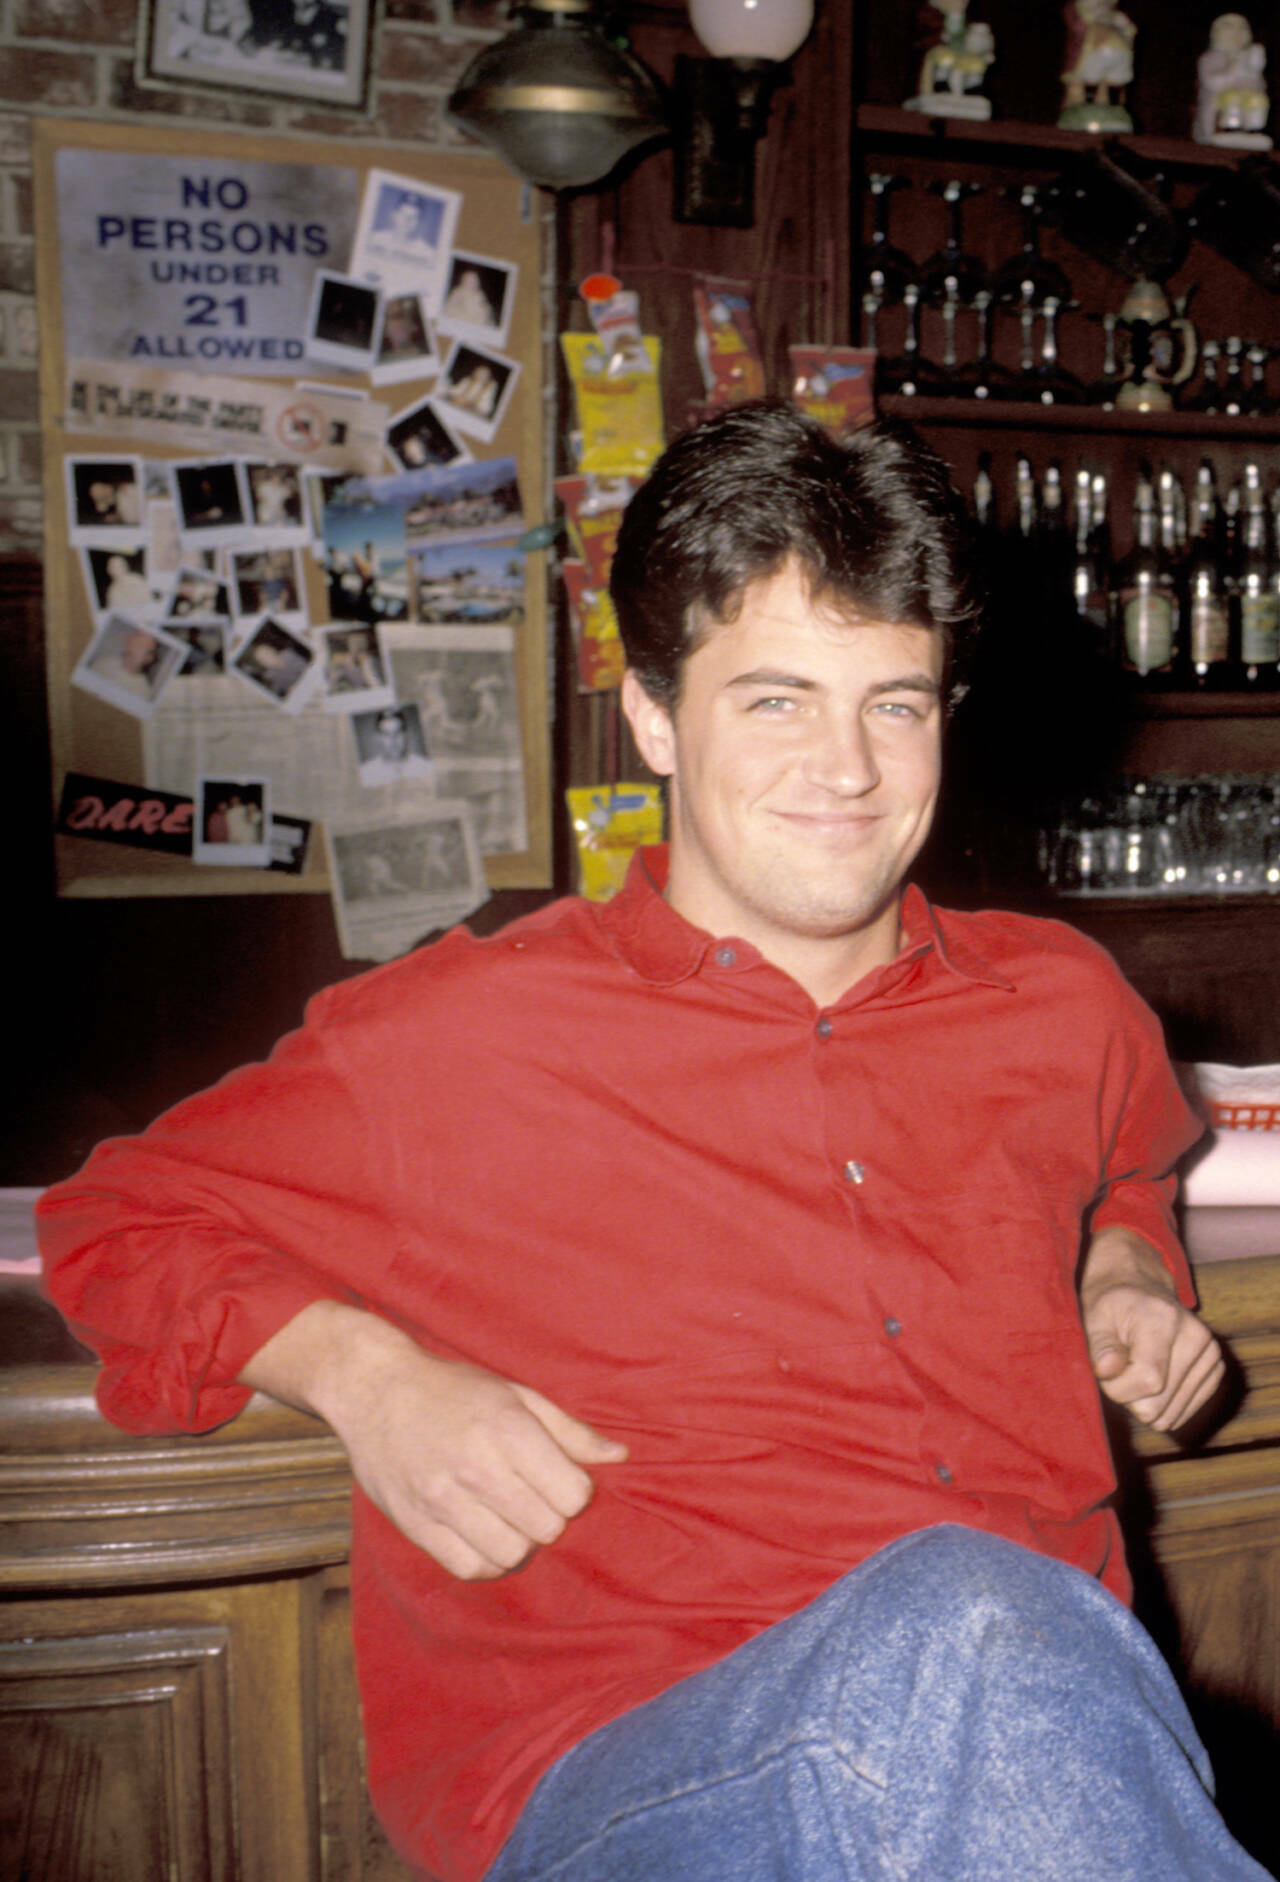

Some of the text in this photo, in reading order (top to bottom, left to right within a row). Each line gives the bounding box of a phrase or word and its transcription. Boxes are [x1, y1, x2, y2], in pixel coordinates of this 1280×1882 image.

[181, 175, 248, 211] NO
[98, 215, 330, 258] PERSONS
[151, 261, 281, 287] UNDER
[184, 294, 248, 327] 21
[130, 334, 304, 361] ALLOWED
[66, 795, 196, 835] DARE
